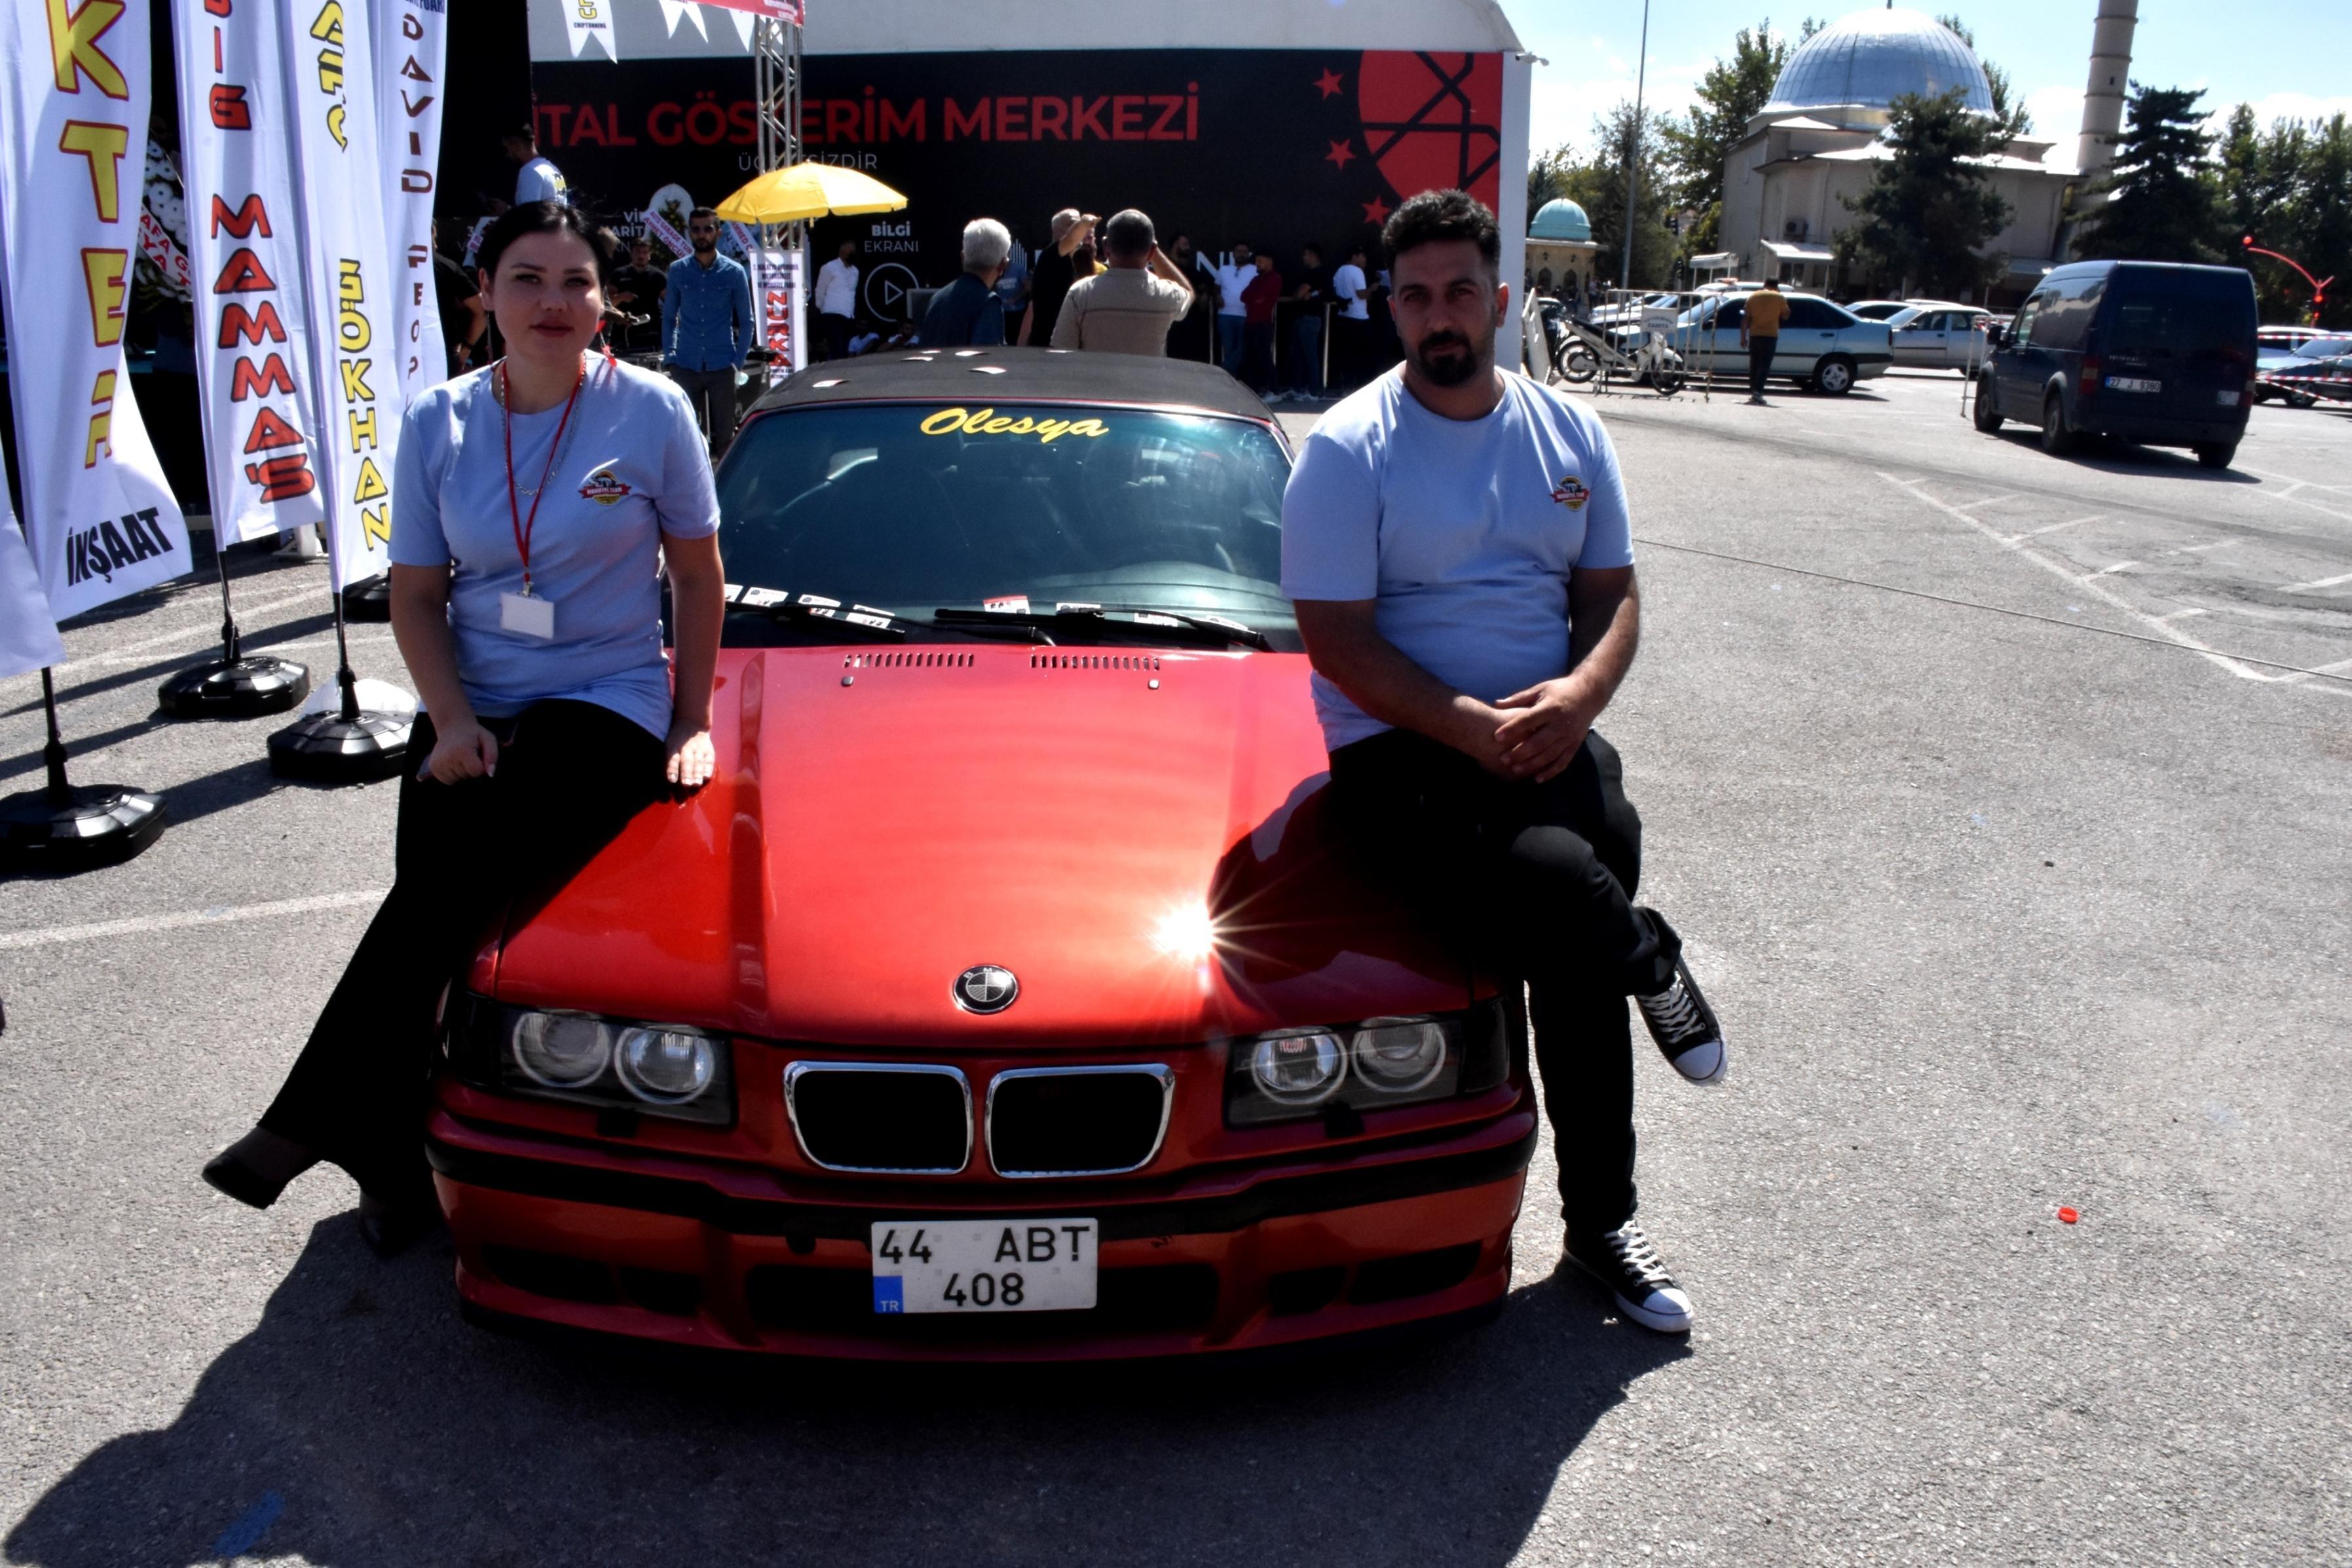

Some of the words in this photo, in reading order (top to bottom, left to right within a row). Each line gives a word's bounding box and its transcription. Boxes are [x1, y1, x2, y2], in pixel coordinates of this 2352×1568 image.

[400, 13, 435, 194] DAVID
[944, 81, 1199, 141] MERKEZİ
[865, 240, 918, 252] EKRANI
[871, 220, 911, 236] BİLGİ
[406, 244, 428, 407] PEOP
[211, 193, 315, 504] MAMMA'S
[920, 407, 1110, 443] Olesya
[880, 1229, 932, 1264] 44
[994, 1225, 1090, 1263] ABT
[880, 1300, 899, 1311] TR
[943, 1273, 1024, 1307] 408
